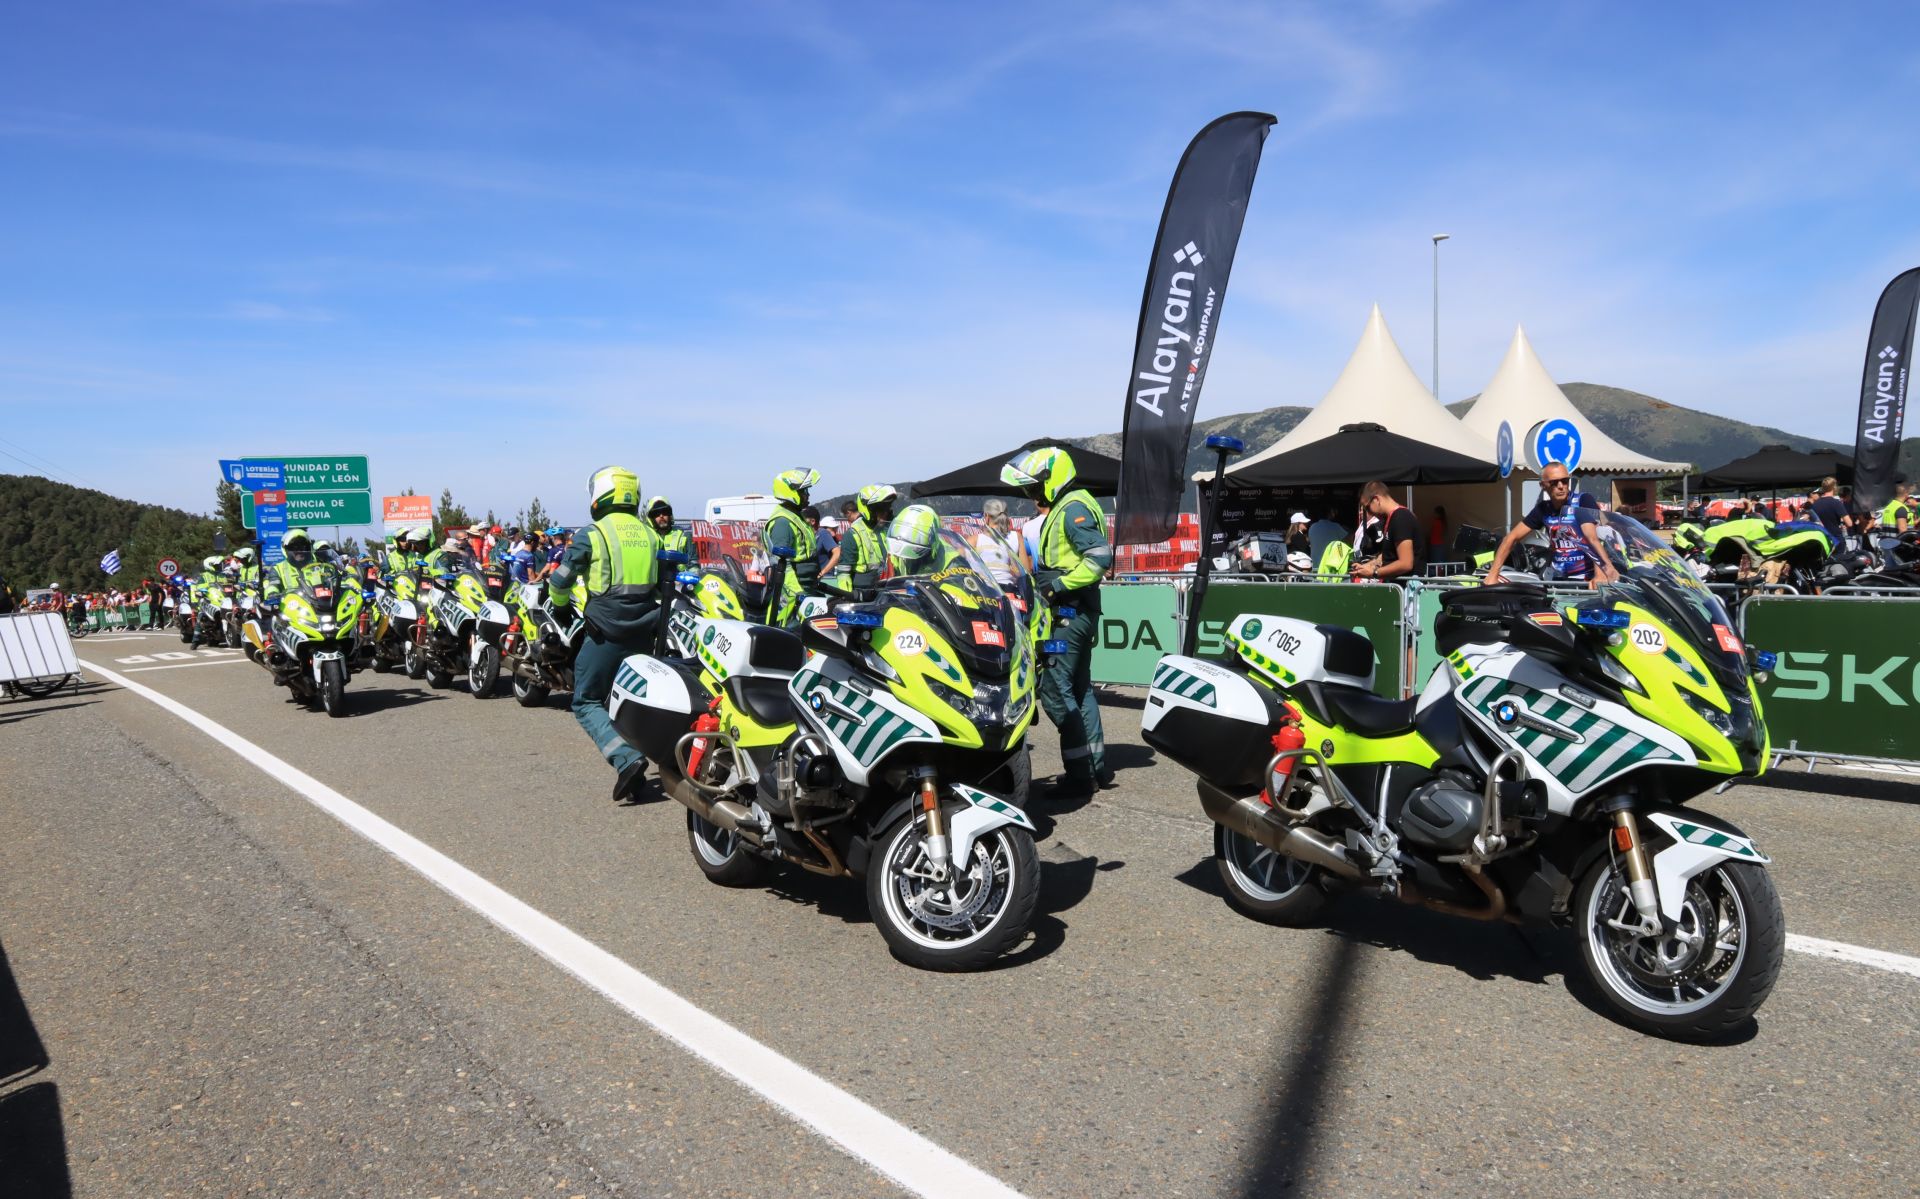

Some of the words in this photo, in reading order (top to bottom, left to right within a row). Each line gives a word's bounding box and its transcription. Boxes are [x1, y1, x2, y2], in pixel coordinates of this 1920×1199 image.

[1193, 287, 1217, 355] COMPANY
[1136, 271, 1195, 417] Alayan
[1864, 362, 1895, 443] Alayan
[283, 463, 330, 471] MUNIDAD
[335, 463, 349, 471] DE
[320, 475, 326, 483] Y
[332, 474, 360, 483] LEÓN
[286, 500, 325, 508] OVINCIA
[331, 499, 345, 507] DE
[286, 511, 331, 519] SEGOVIA
[717, 635, 732, 656] 062
[897, 635, 923, 649] 224
[1277, 632, 1301, 656] 062
[1633, 629, 1662, 646] 202
